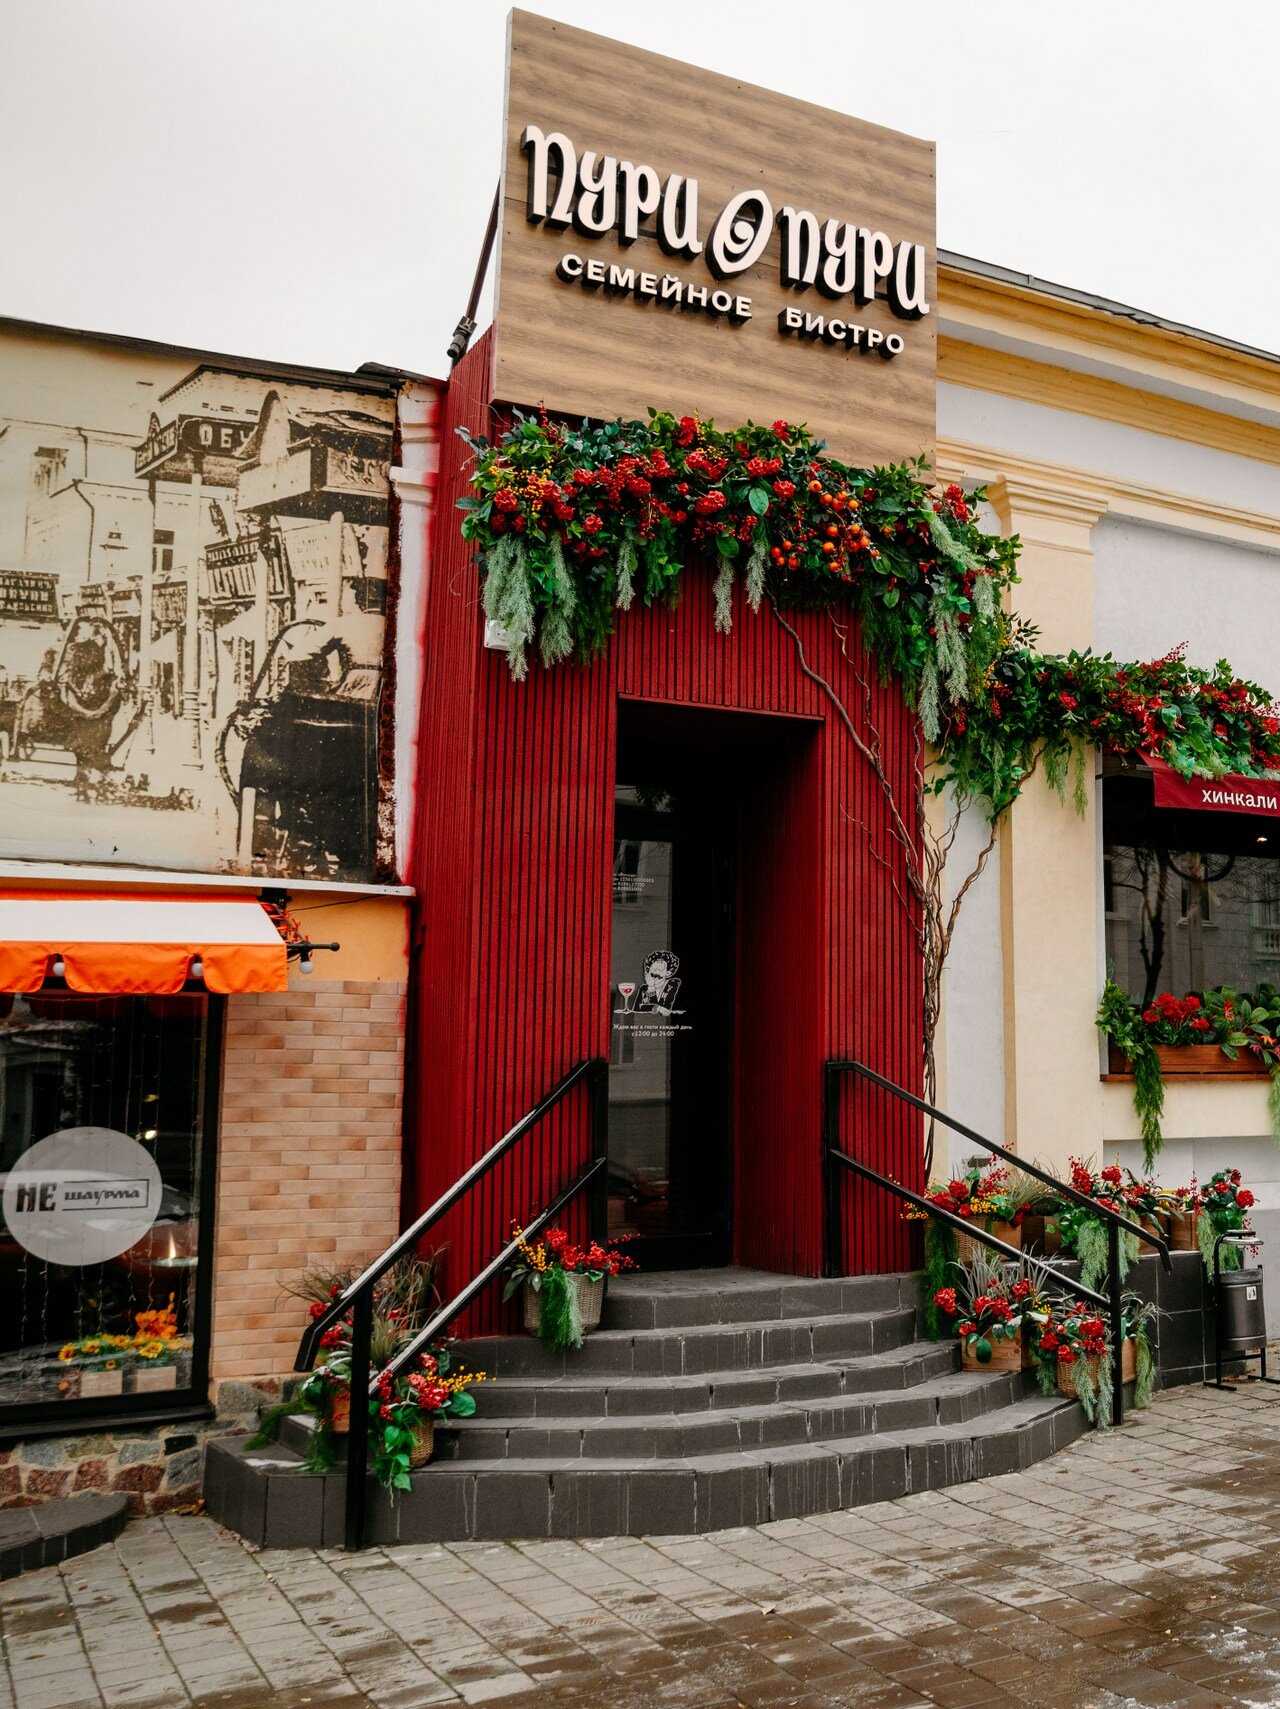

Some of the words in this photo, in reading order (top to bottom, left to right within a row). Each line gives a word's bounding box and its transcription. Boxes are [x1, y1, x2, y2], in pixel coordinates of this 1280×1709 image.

[560, 253, 753, 319] СЕМЕЙНОЕ
[783, 306, 905, 355] БИСТРО
[1201, 789, 1278, 810] хинкали
[15, 1181, 58, 1213] НЕ
